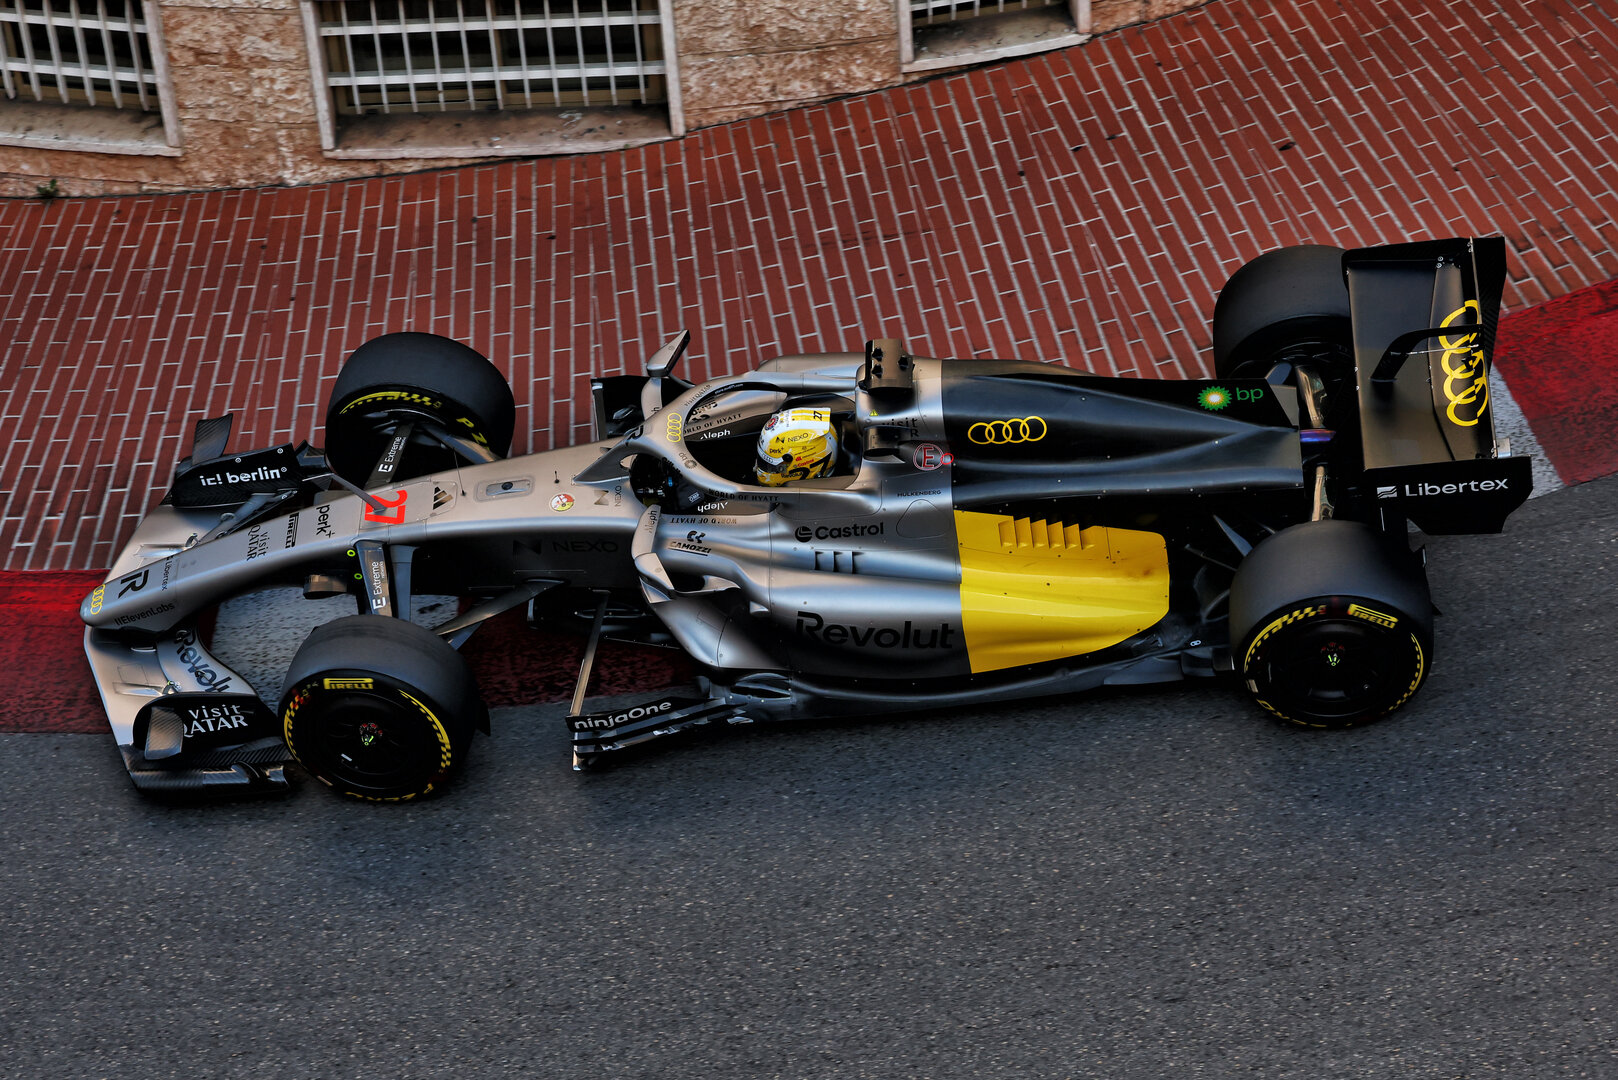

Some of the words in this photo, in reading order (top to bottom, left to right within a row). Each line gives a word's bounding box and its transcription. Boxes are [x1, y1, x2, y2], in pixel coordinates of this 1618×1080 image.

[1235, 387, 1264, 403] bp
[716, 413, 742, 424] HYATT
[813, 410, 823, 421] 27
[700, 429, 731, 440] Aleph
[787, 432, 809, 443] NEXO
[384, 436, 402, 463] Extreme
[922, 446, 935, 469] E
[226, 466, 281, 485] berlin
[614, 485, 622, 507] NEXO
[708, 488, 736, 500] WORLD
[1404, 478, 1509, 497] Libertex
[364, 489, 408, 525] 27
[697, 501, 729, 513] Aleph
[285, 512, 300, 549] PIRELLI
[670, 517, 696, 525] HYATT
[815, 521, 884, 540] Castrol
[246, 524, 261, 562] QATAR
[257, 531, 270, 557] visit
[552, 540, 619, 553] NEXO
[669, 541, 712, 555] CAMOZZI
[162, 560, 173, 591] Libertex
[371, 561, 383, 596] Extreme
[1347, 603, 1399, 630] PIRELLI
[796, 610, 955, 649] Revolut
[323, 677, 375, 690] PIRELLI
[187, 703, 241, 720] visit
[574, 701, 672, 729] ninjaOne
